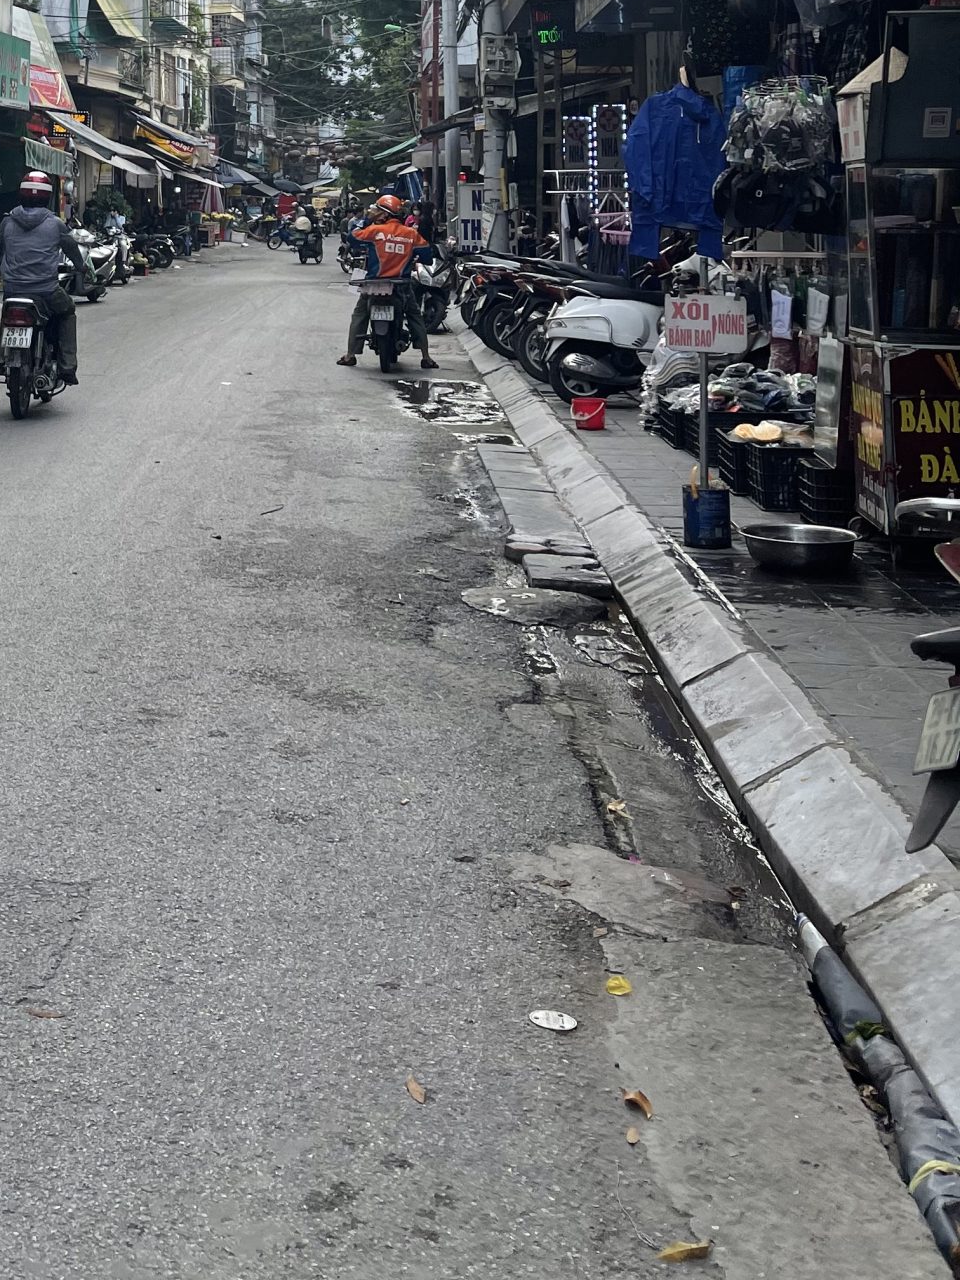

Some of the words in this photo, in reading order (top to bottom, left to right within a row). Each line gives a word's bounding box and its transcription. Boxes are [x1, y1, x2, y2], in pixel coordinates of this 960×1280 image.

[671, 299, 709, 320] XÔI
[718, 310, 744, 335] NÓNG
[668, 325, 692, 346] BÁNH
[694, 329, 712, 347] BAO
[920, 446, 960, 483] ĐÀ
